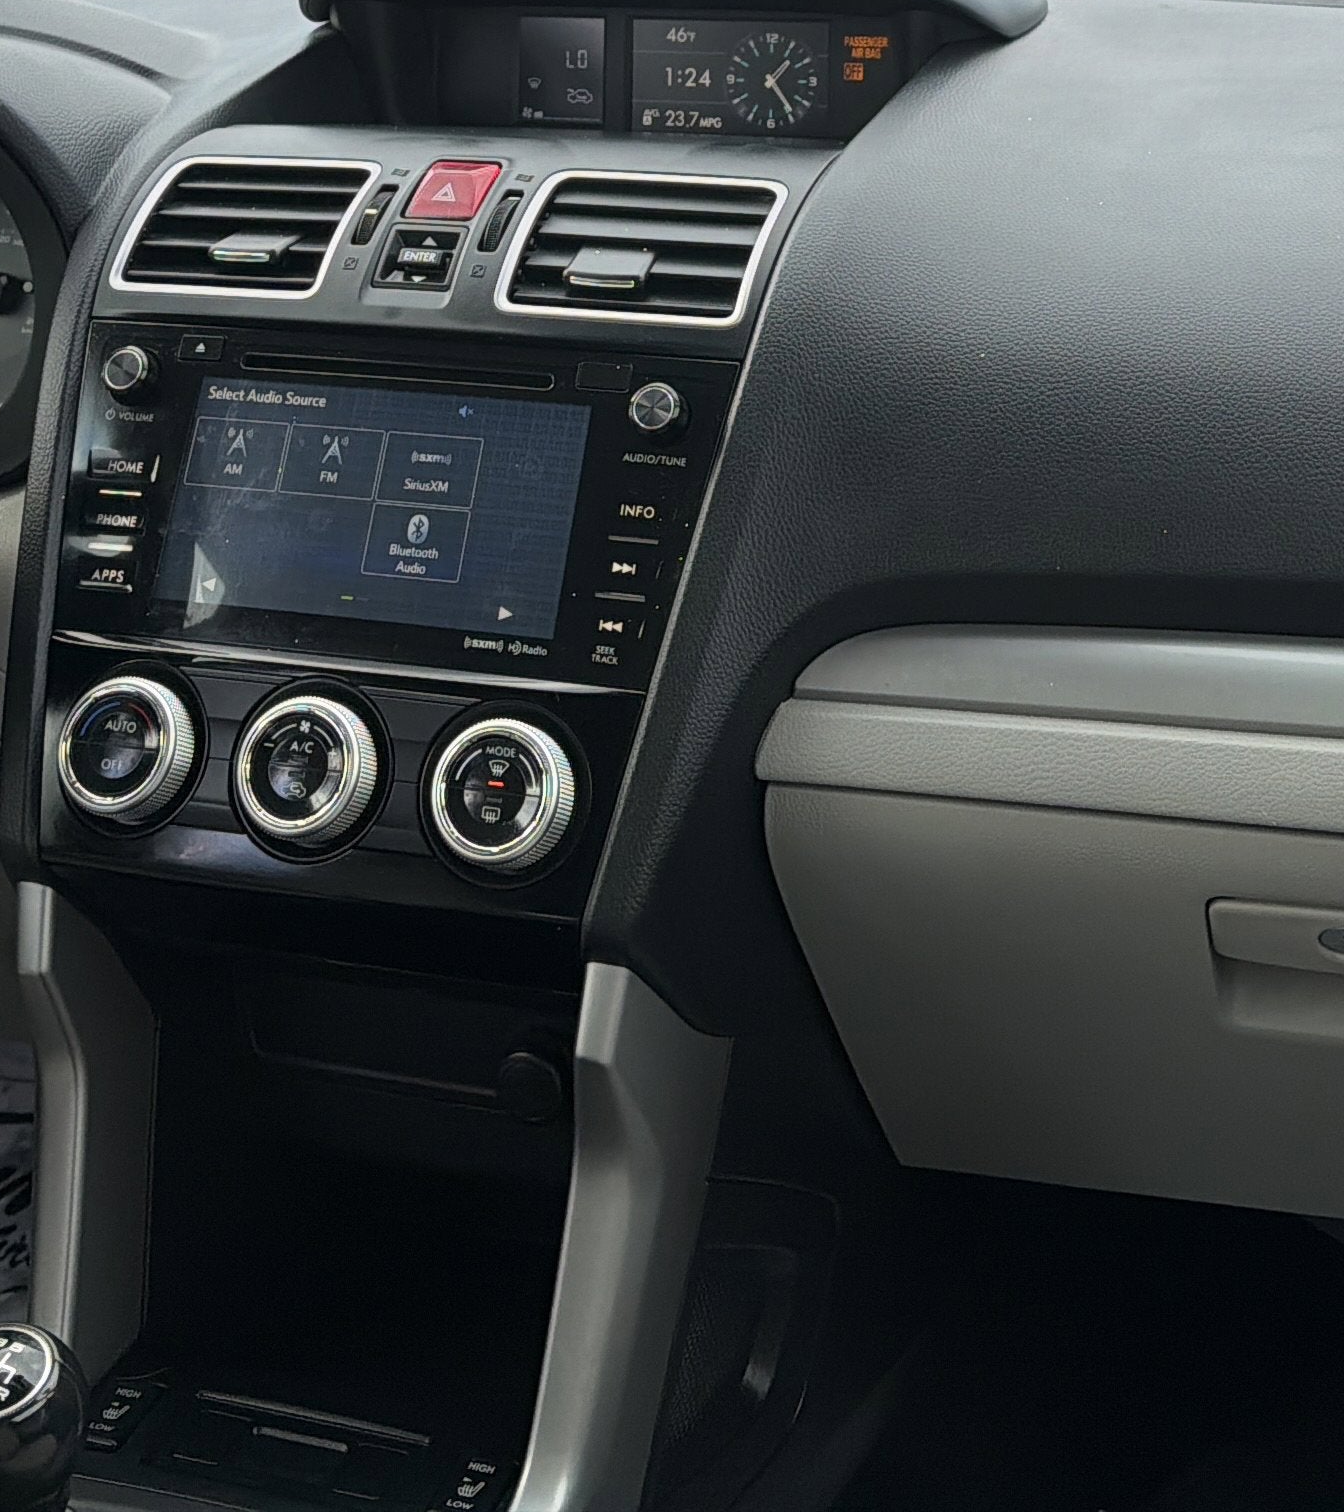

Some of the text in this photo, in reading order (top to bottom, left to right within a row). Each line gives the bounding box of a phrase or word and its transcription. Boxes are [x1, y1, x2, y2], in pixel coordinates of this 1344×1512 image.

[765, 33, 779, 45] 12
[844, 36, 889, 48] PASSENGER
[665, 67, 711, 88] 1:24
[844, 63, 864, 80] OFF
[726, 74, 735, 85] 9
[808, 75, 818, 87] 3
[665, 109, 699, 128] 23.7
[767, 119, 776, 129] 6
[404, 250, 437, 263] ENTER
[208, 386, 327, 408] Select Audio Source
[118, 411, 155, 423] VOLUME
[107, 459, 145, 474] HOME
[622, 452, 688, 468] AUDIO/TUNE
[223, 463, 244, 476] AM
[319, 471, 339, 484] FM
[403, 478, 449, 493] SiriusXM
[619, 503, 656, 520] INFO
[96, 513, 139, 528] PHONE
[388, 543, 440, 560] Bluetooth
[395, 560, 427, 575] Audio
[90, 569, 125, 583] APPS
[522, 644, 548, 656] Radio
[595, 645, 616, 656] SEEK
[591, 654, 619, 666] TRACK
[104, 718, 138, 734] AUTO
[289, 739, 314, 755] A/C
[485, 745, 518, 760] MODE
[100, 758, 123, 772] OFF
[115, 1386, 142, 1400] HIGH
[88, 1420, 115, 1434] LOW
[467, 1460, 497, 1475] HIGH
[445, 1498, 475, 1511] LOW
